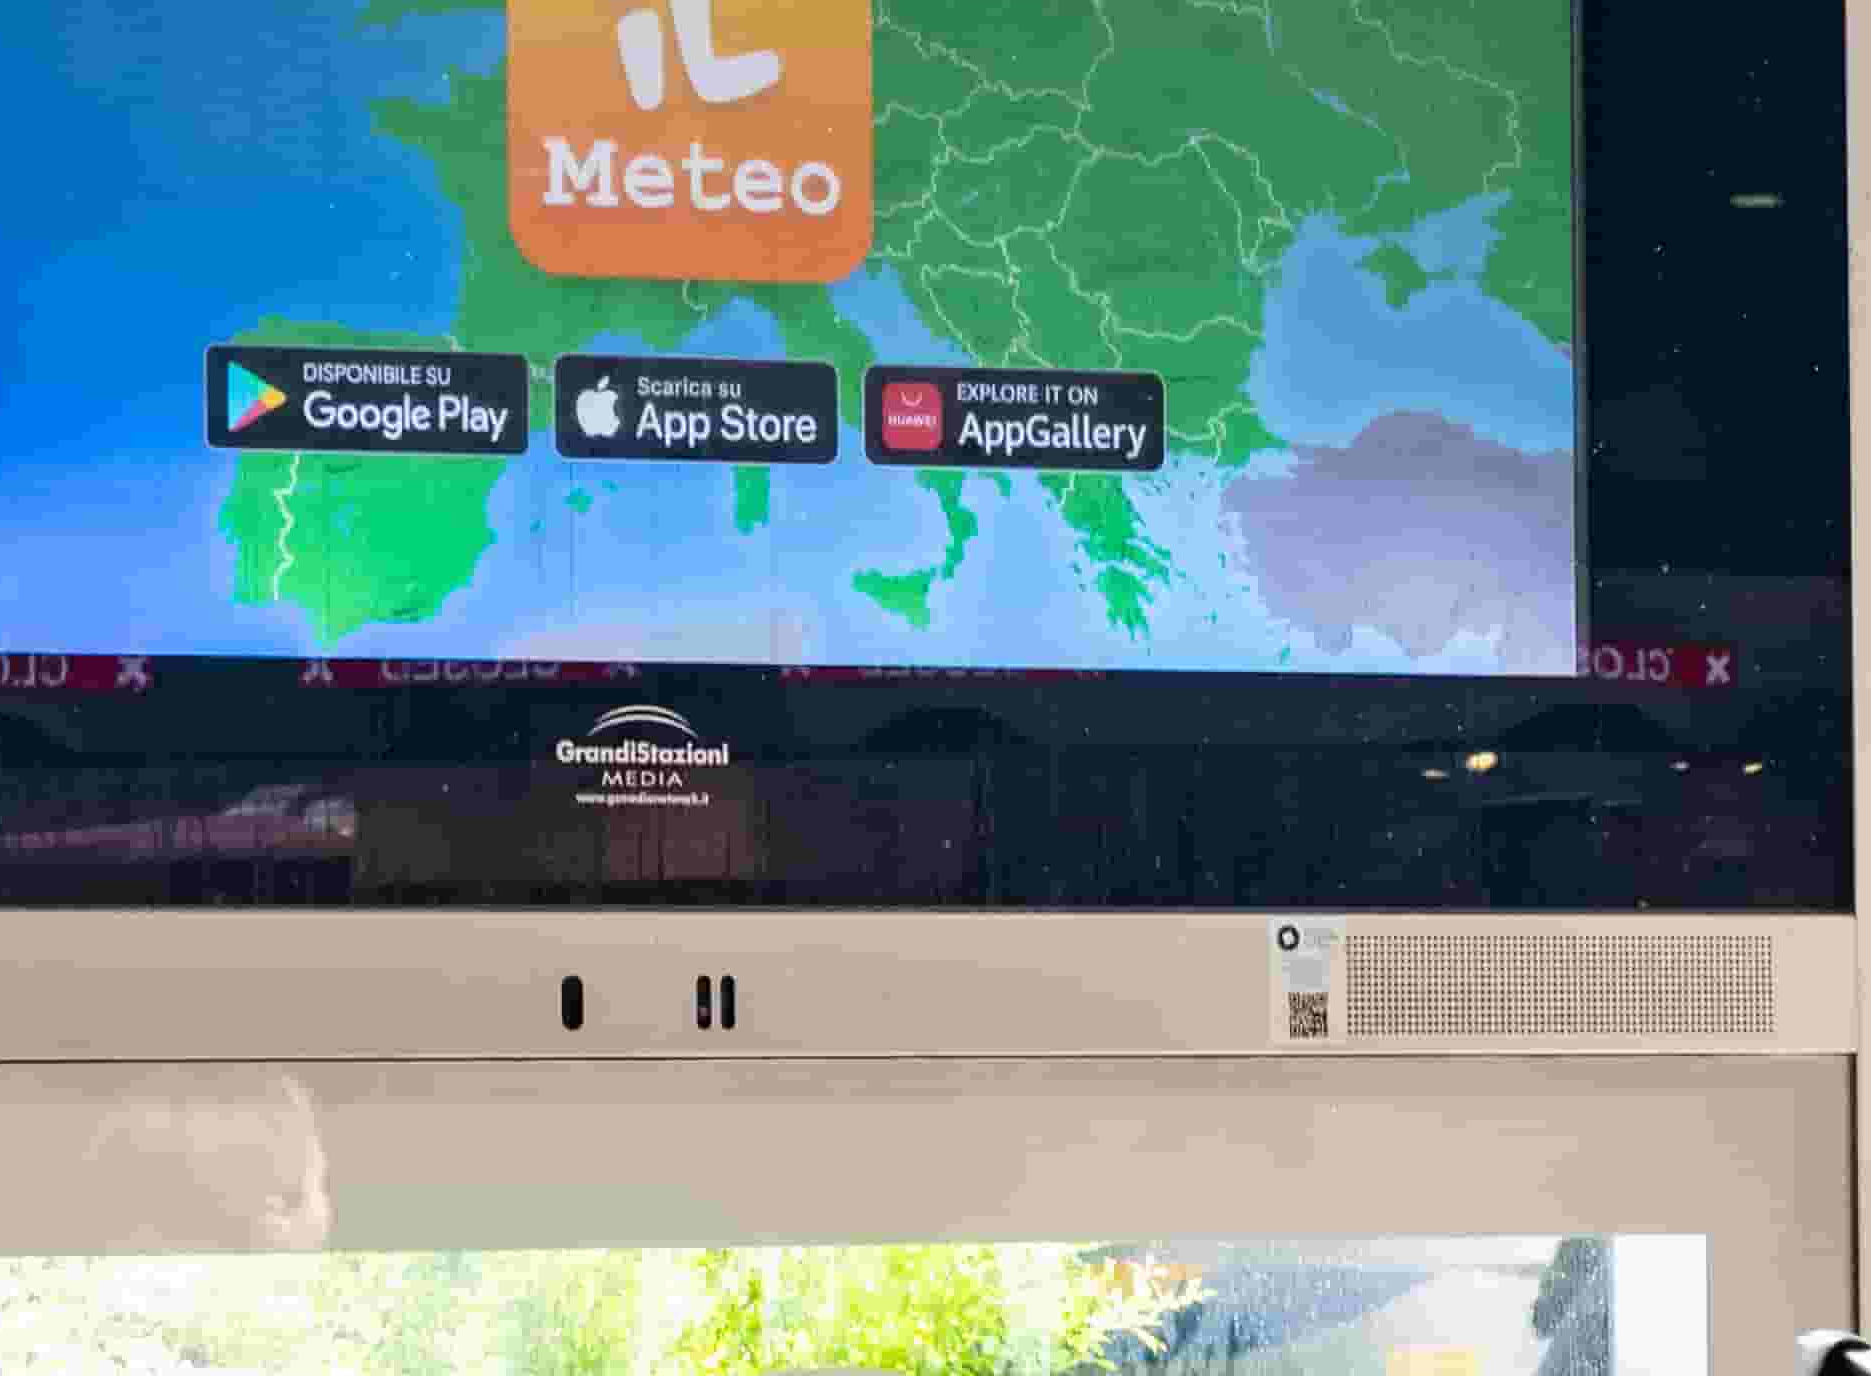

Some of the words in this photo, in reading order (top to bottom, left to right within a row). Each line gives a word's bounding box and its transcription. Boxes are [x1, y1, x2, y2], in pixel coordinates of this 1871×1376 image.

[541, 136, 840, 215] Meteo
[303, 362, 421, 384] DISPONIBILE
[425, 367, 450, 386] SU
[637, 376, 713, 397] Scarica
[718, 381, 742, 399] su
[957, 382, 1040, 403] EXPLORE
[1044, 385, 1062, 404] IT
[1068, 386, 1099, 406] ON
[303, 390, 428, 440] Google
[439, 393, 507, 442] Play
[636, 402, 711, 448] App
[721, 403, 818, 443] Store
[958, 412, 1146, 459] AppGallery
[556, 739, 730, 766] GrandiStazioni
[602, 770, 683, 788] MEDIA
